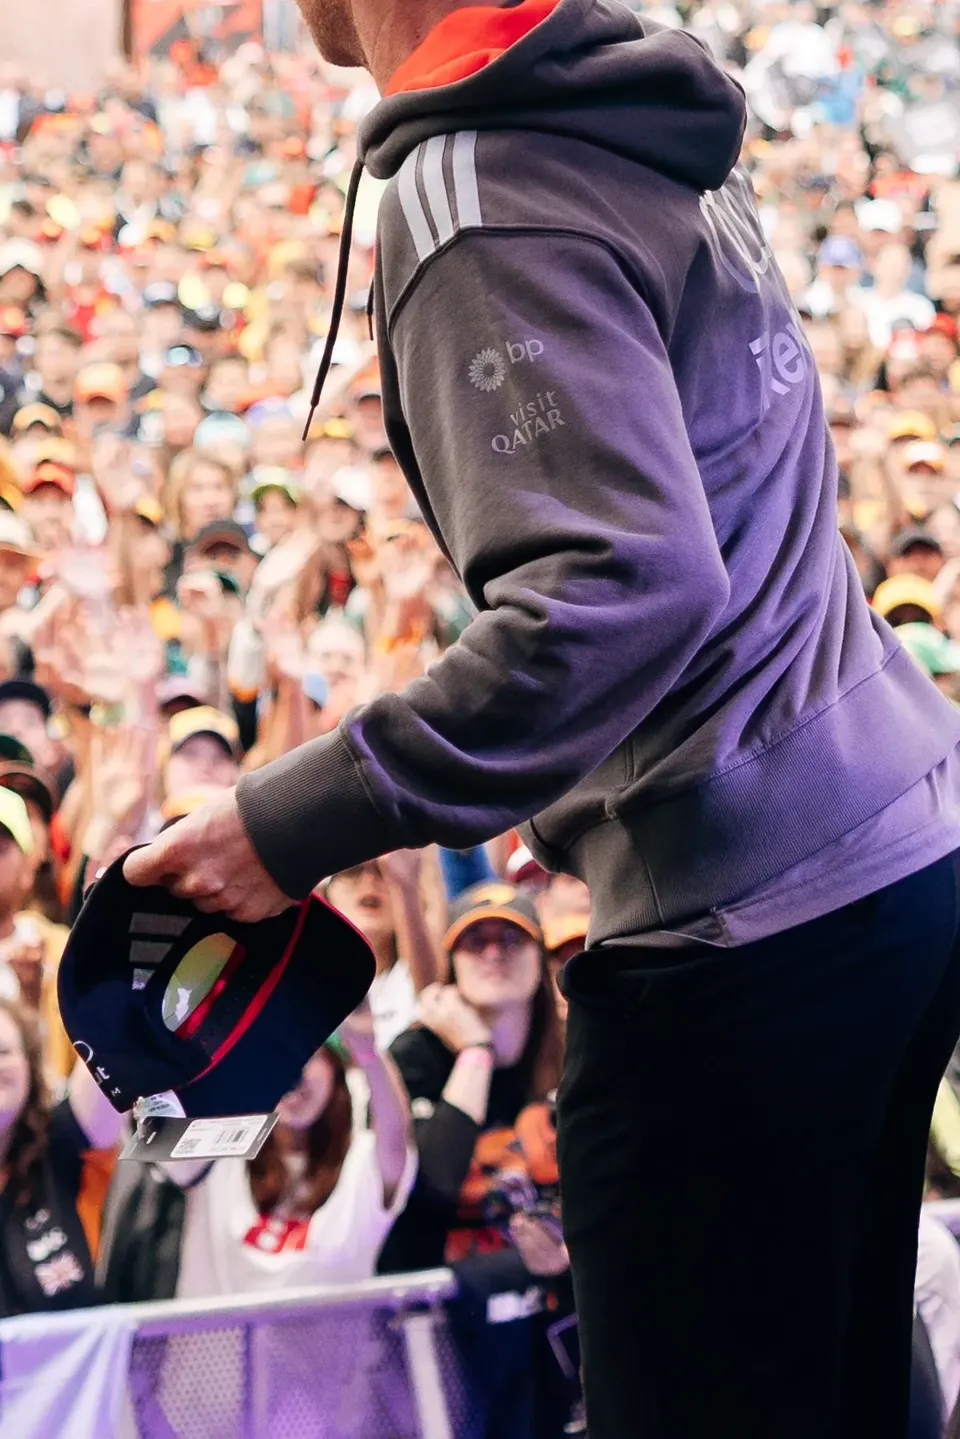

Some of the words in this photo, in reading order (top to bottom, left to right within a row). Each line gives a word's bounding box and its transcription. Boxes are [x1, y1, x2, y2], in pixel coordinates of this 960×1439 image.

[505, 339, 544, 364] bp
[510, 391, 557, 426] visit
[491, 408, 566, 454] QATAR
